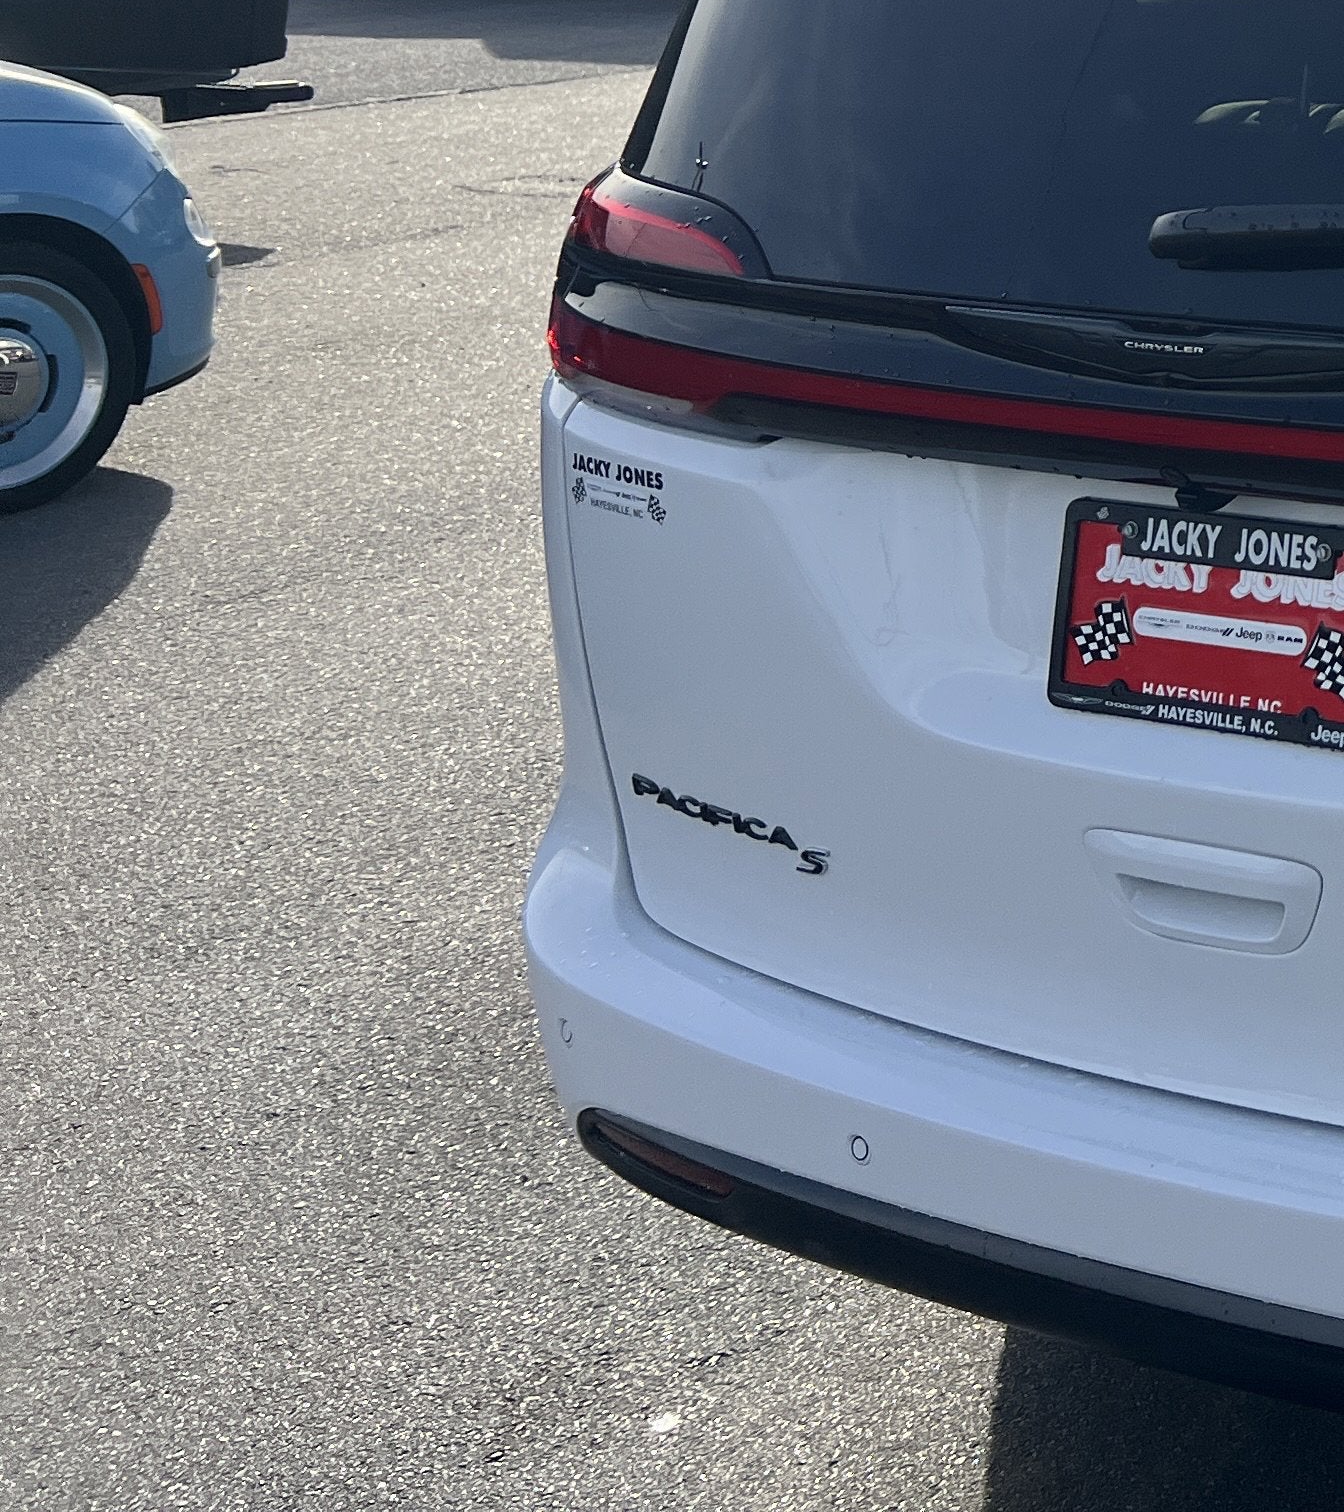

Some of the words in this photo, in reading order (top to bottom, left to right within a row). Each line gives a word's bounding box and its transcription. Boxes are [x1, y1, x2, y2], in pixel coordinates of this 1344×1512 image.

[1124, 341, 1204, 353] CHRYSLER
[572, 452, 611, 478] JACKY
[615, 464, 664, 490] JONES
[1140, 517, 1222, 559] JACKY
[1234, 528, 1318, 571] JONES
[1096, 543, 1212, 594] JACKY
[1235, 626, 1263, 643] Jeep
[1158, 703, 1247, 733] HAYESVILLE,
[1250, 717, 1279, 736] N.C.
[631, 772, 799, 851] PACIFICA
[796, 845, 831, 875] S
